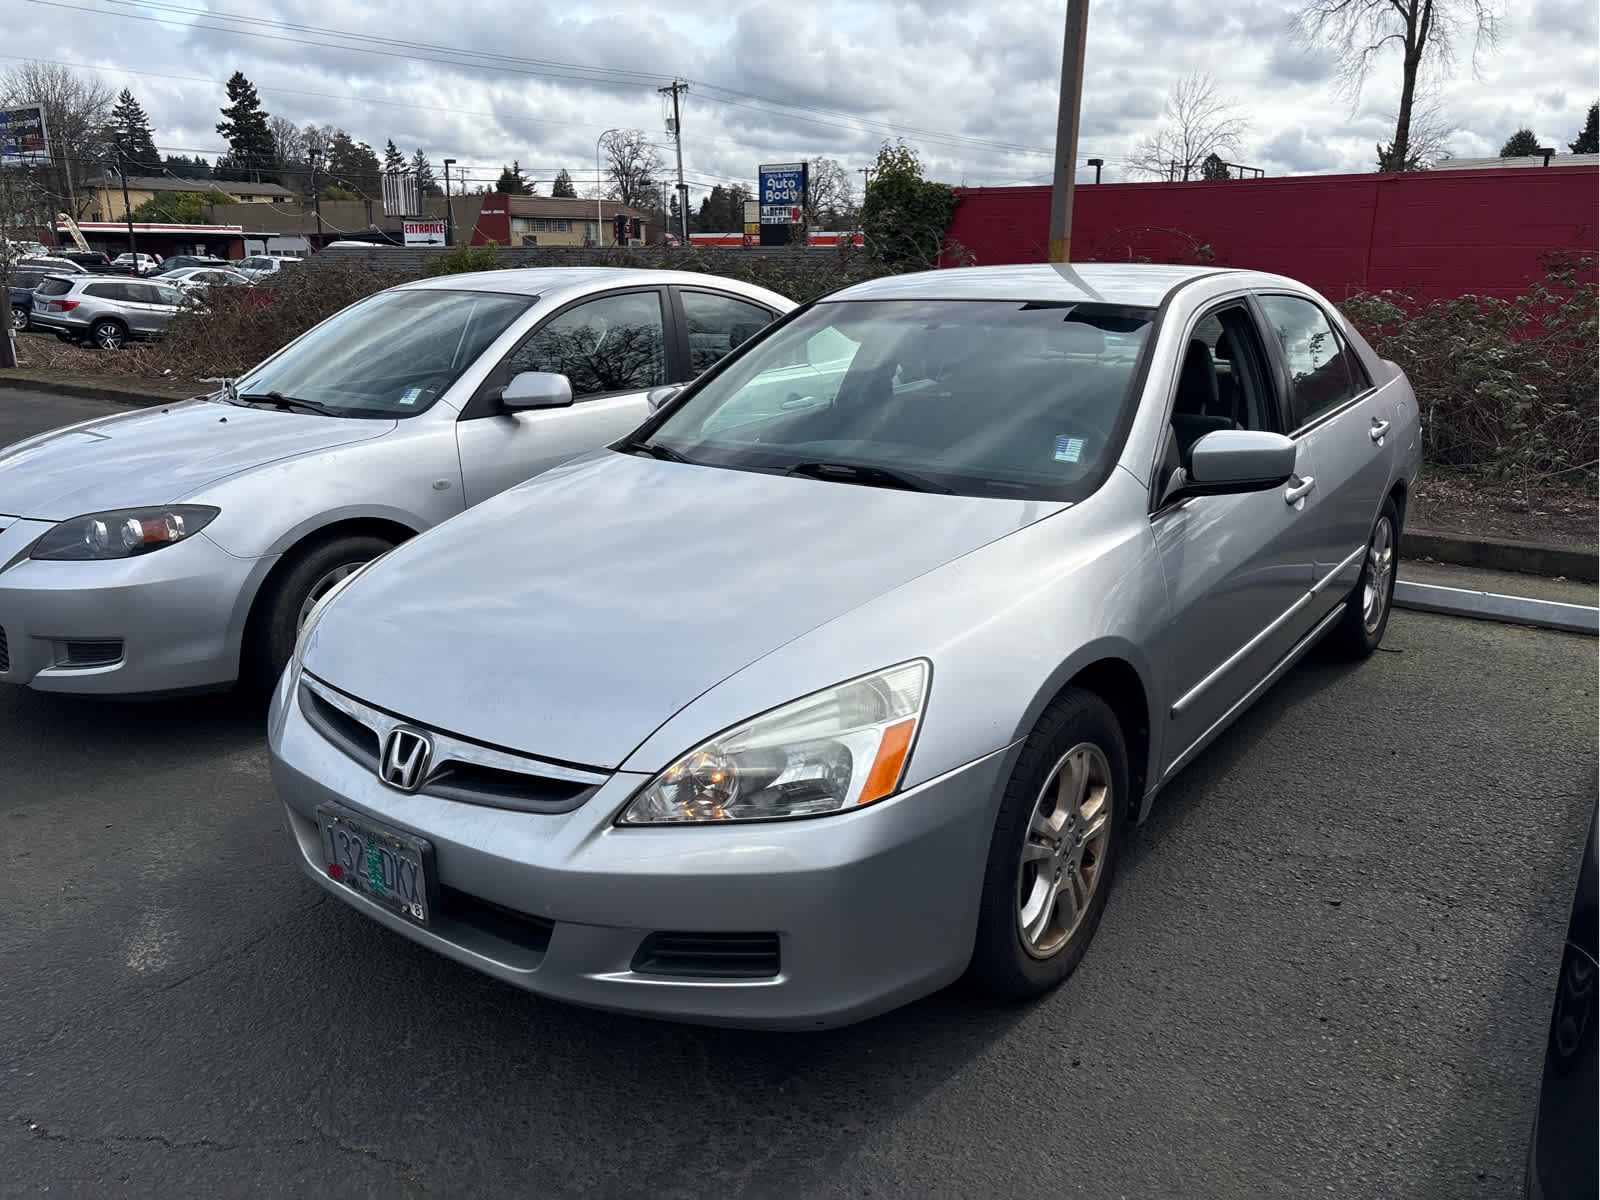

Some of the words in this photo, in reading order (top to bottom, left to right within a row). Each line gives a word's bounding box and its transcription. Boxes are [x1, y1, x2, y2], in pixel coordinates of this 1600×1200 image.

[767, 178, 796, 191] Auto
[765, 189, 798, 203] Body
[404, 223, 444, 234] ENTRANCE
[326, 824, 369, 881] 132
